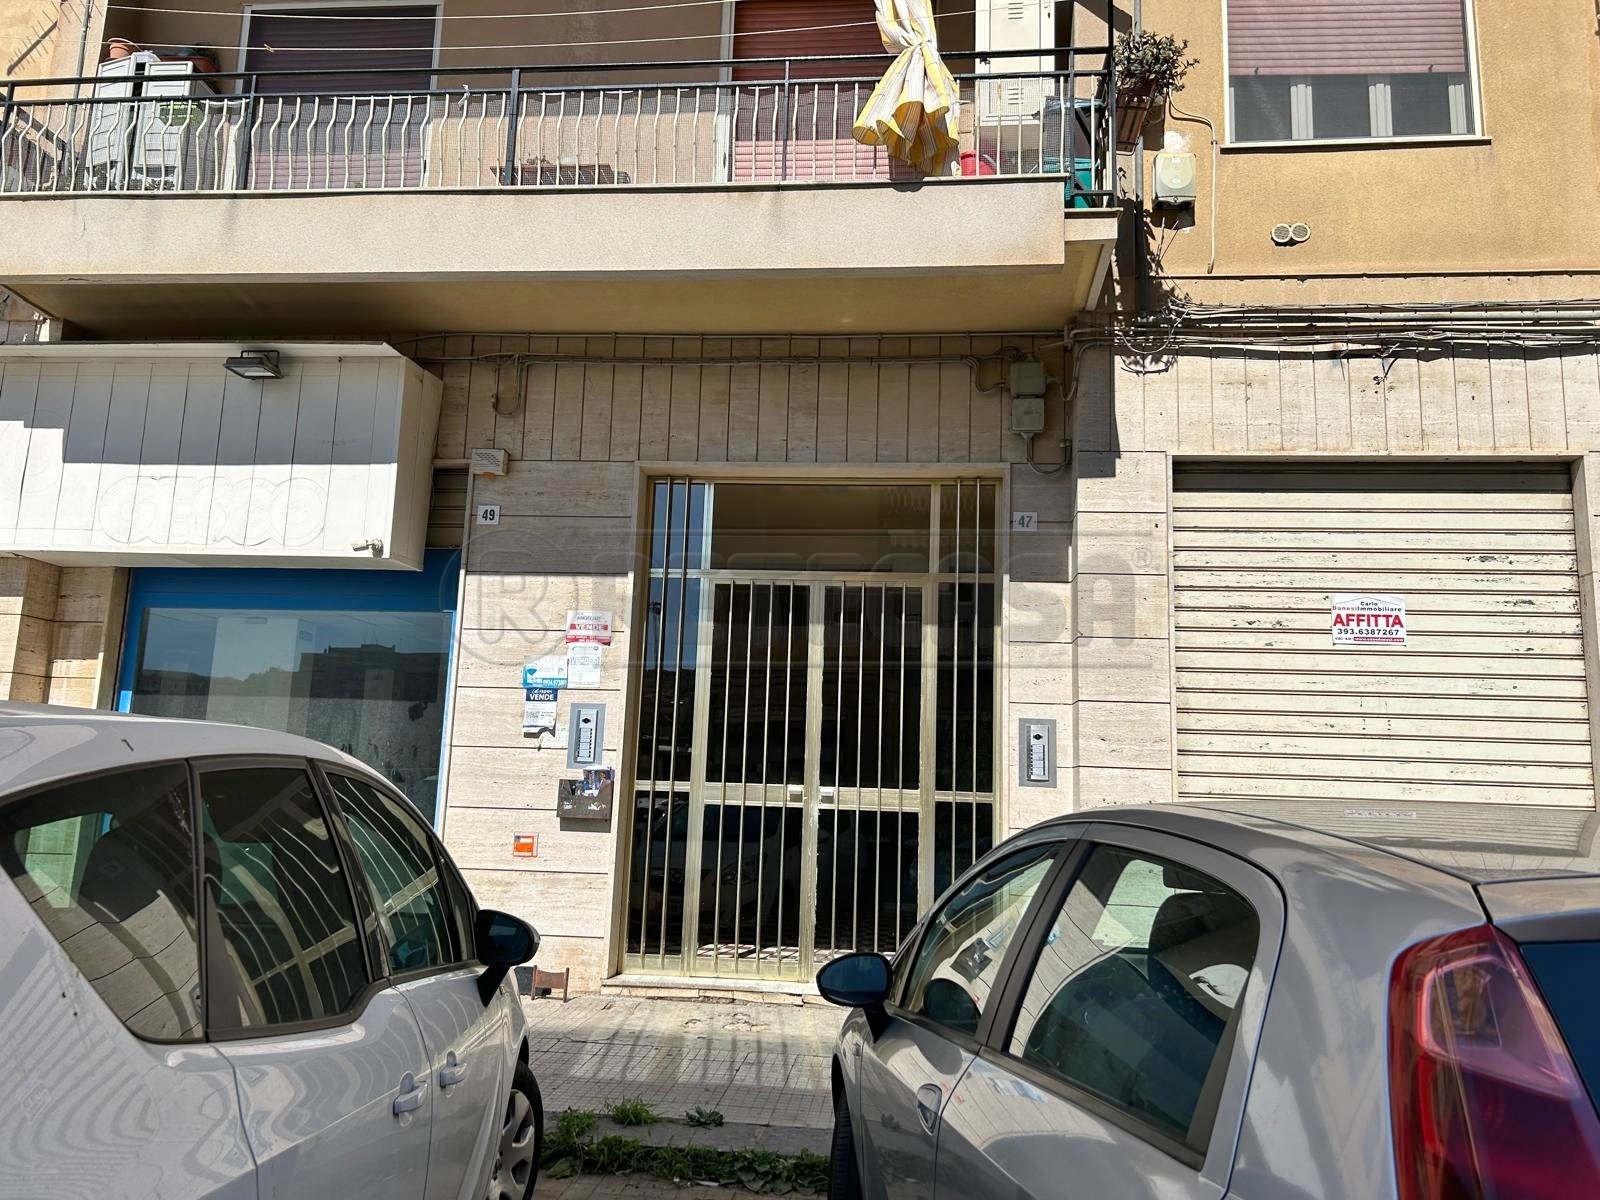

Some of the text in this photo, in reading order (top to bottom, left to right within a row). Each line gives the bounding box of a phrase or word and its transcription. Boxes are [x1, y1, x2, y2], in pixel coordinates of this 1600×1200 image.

[481, 508, 496, 521] 49
[1018, 515, 1033, 528] 47
[1332, 613, 1404, 628] AFFITTA
[1337, 628, 1400, 636] 393.6387267
[529, 692, 555, 701] VENDE
